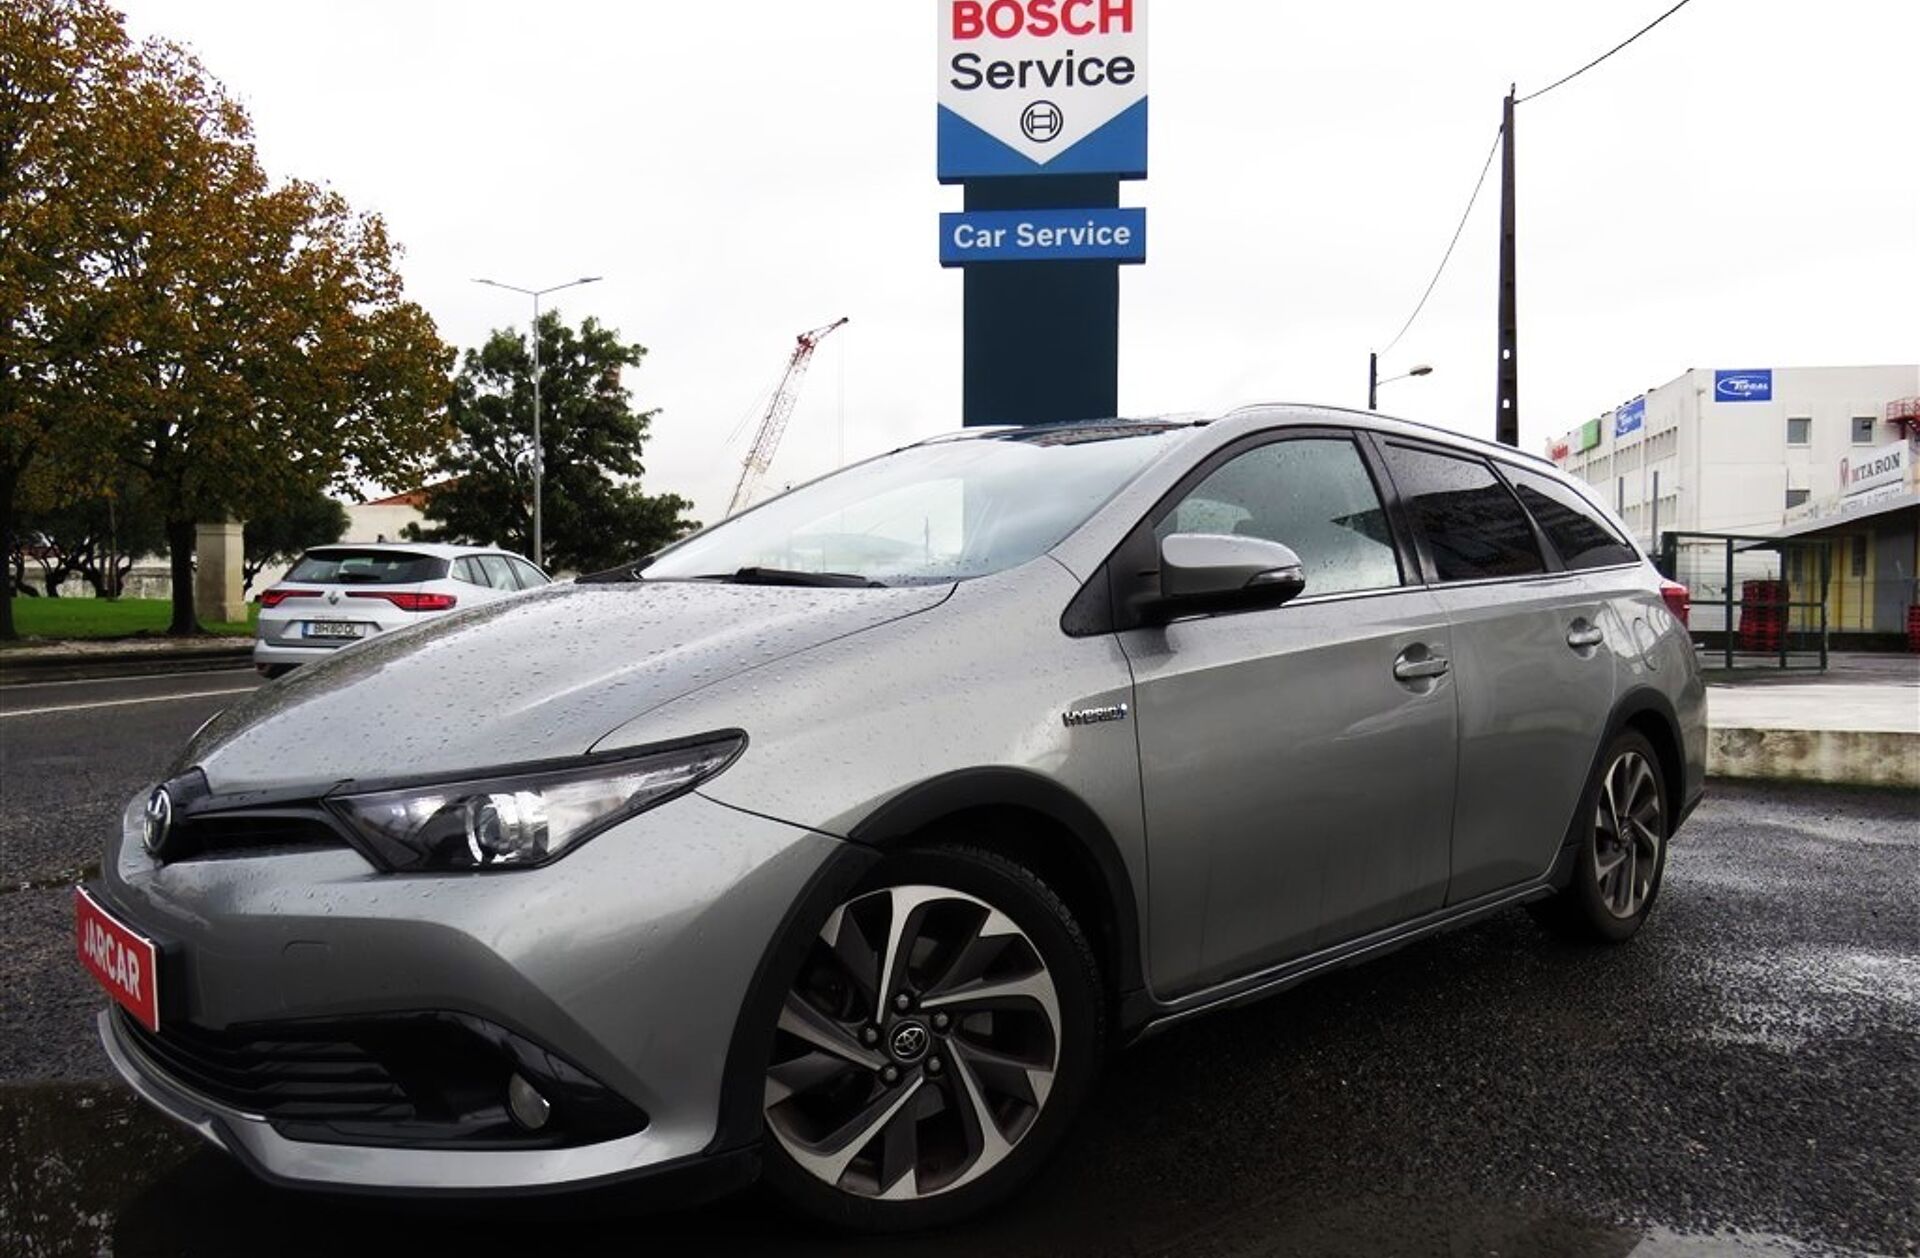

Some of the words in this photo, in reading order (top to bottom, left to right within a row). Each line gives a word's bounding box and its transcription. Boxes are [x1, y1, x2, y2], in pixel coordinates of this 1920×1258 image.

[952, 0, 1133, 40] BOSCH
[950, 50, 1135, 90] Service
[954, 225, 1006, 248] Car
[1016, 221, 1131, 246] Service
[84, 917, 142, 1002] JARCAR
